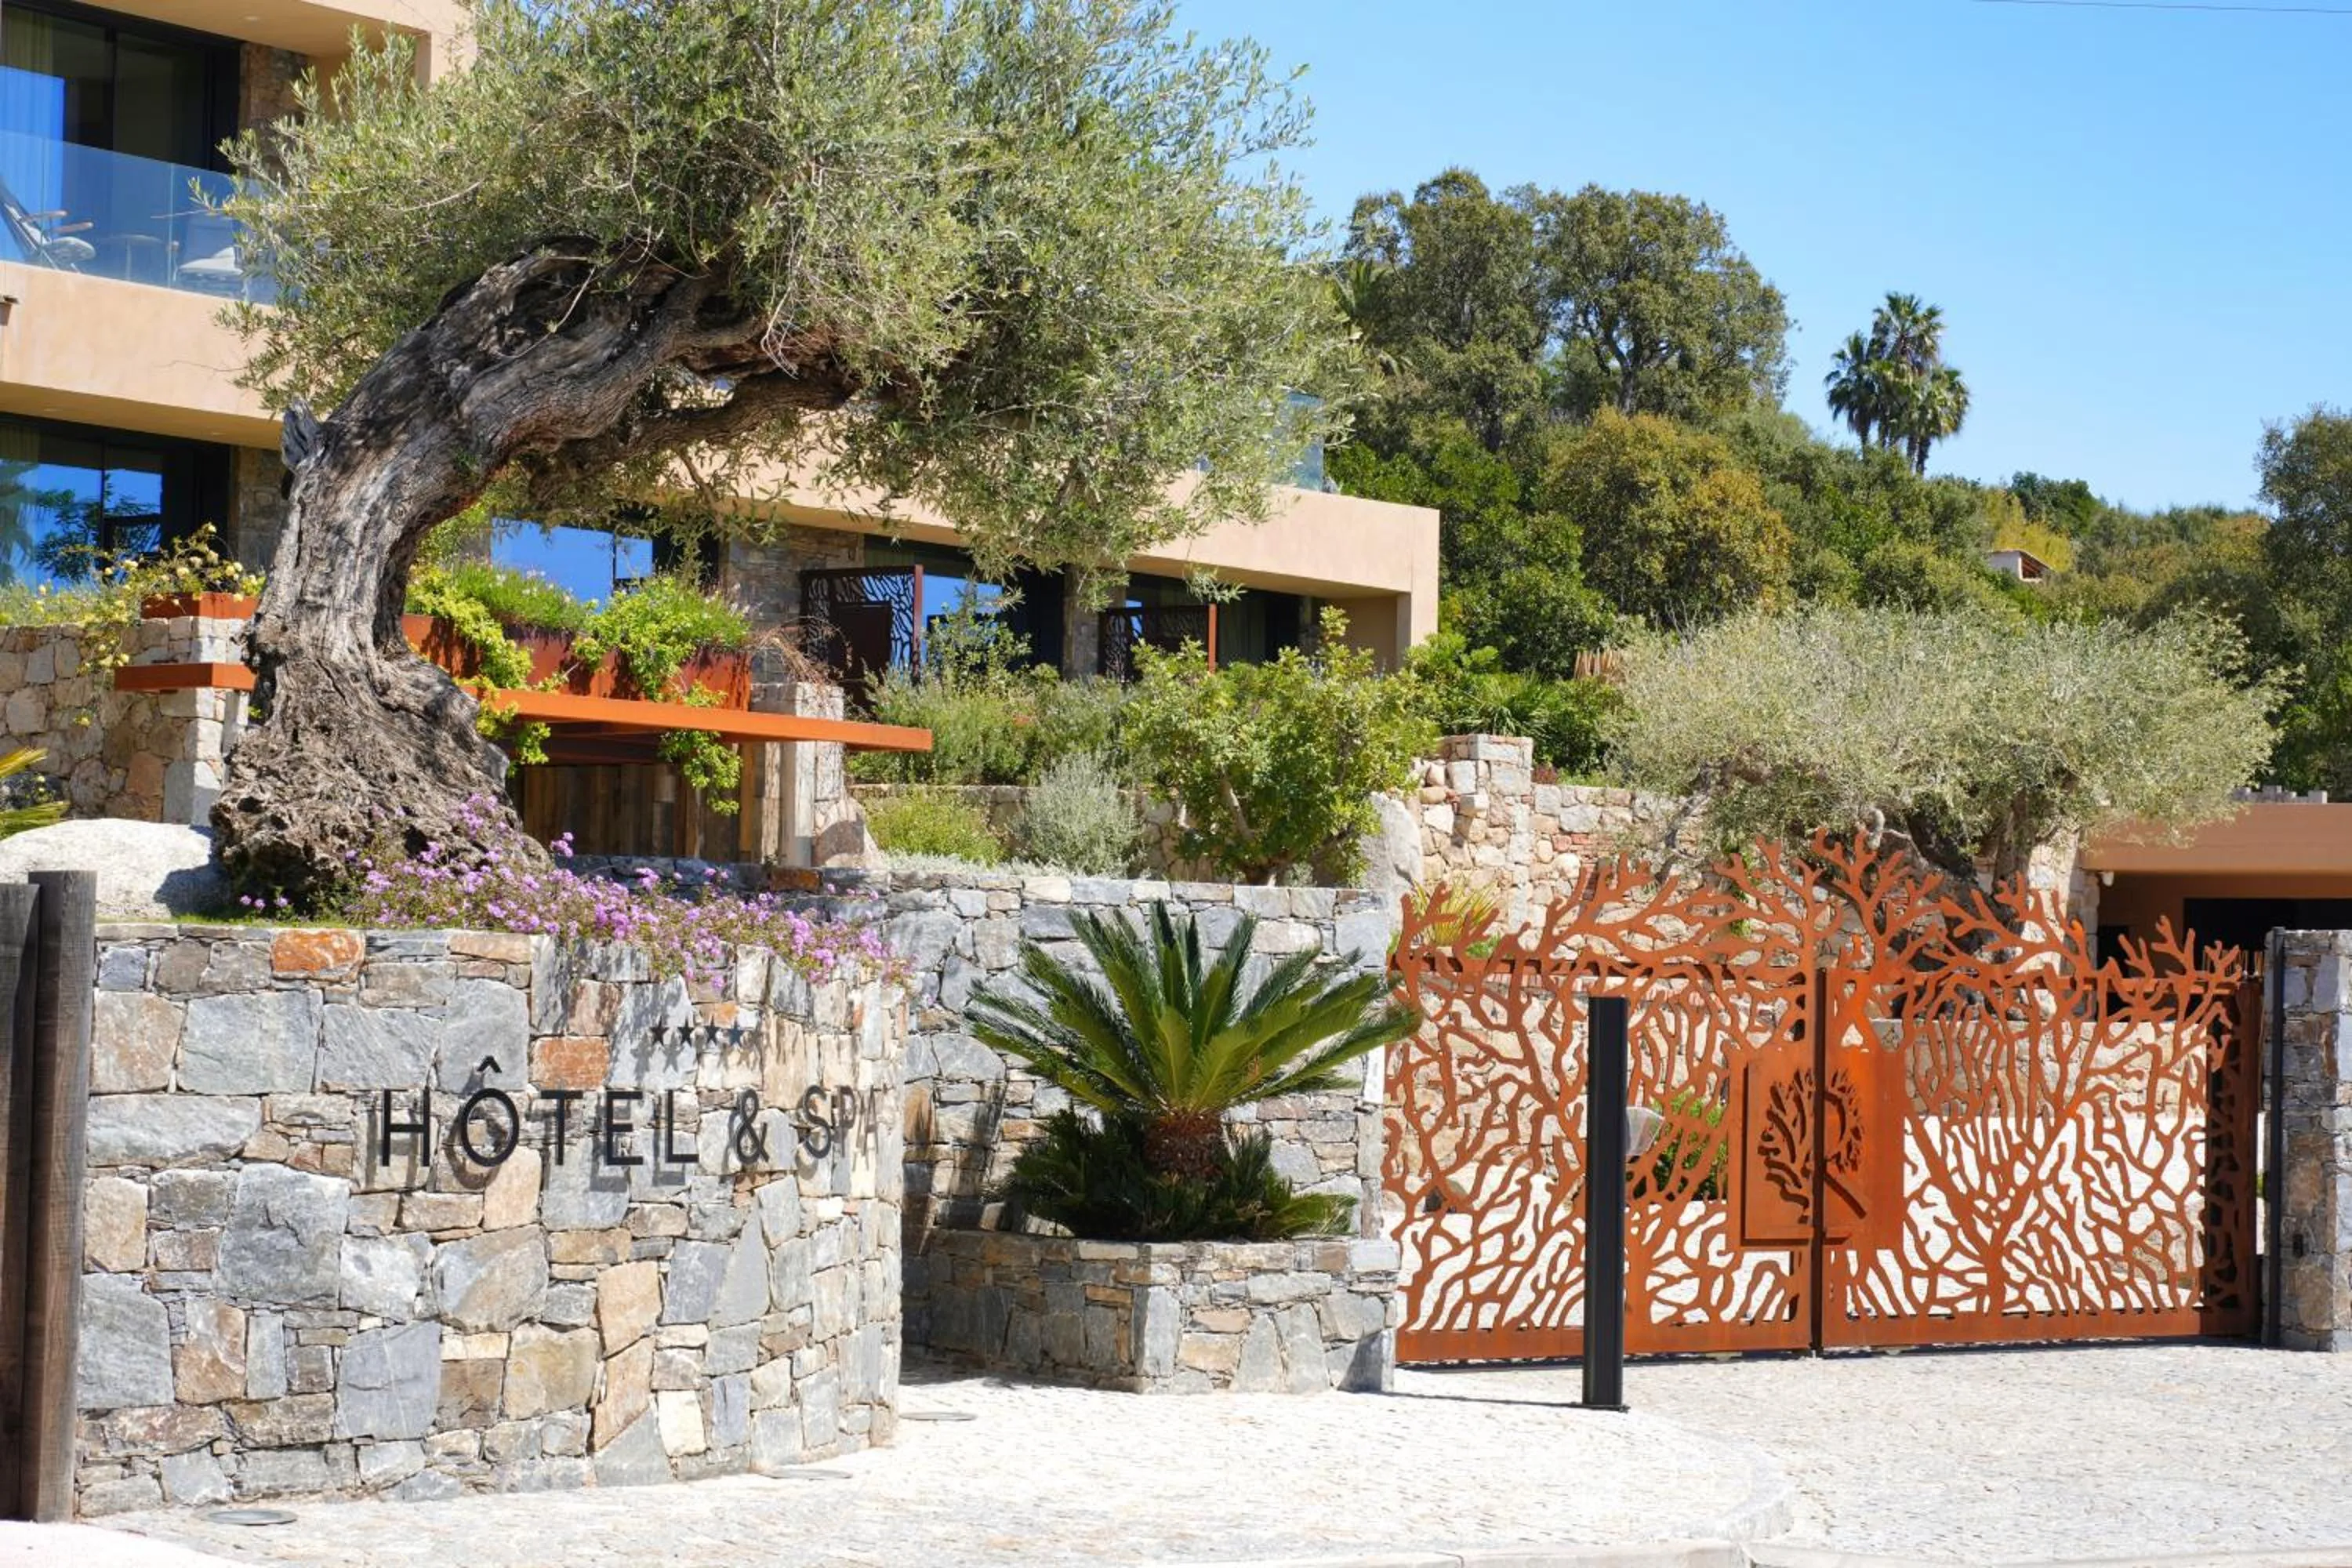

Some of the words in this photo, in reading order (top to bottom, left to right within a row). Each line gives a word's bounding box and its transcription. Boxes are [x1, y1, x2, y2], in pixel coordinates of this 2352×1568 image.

[380, 1054, 699, 1167] HÔTEL
[735, 1087, 770, 1165] &
[801, 1084, 879, 1159] SPA
